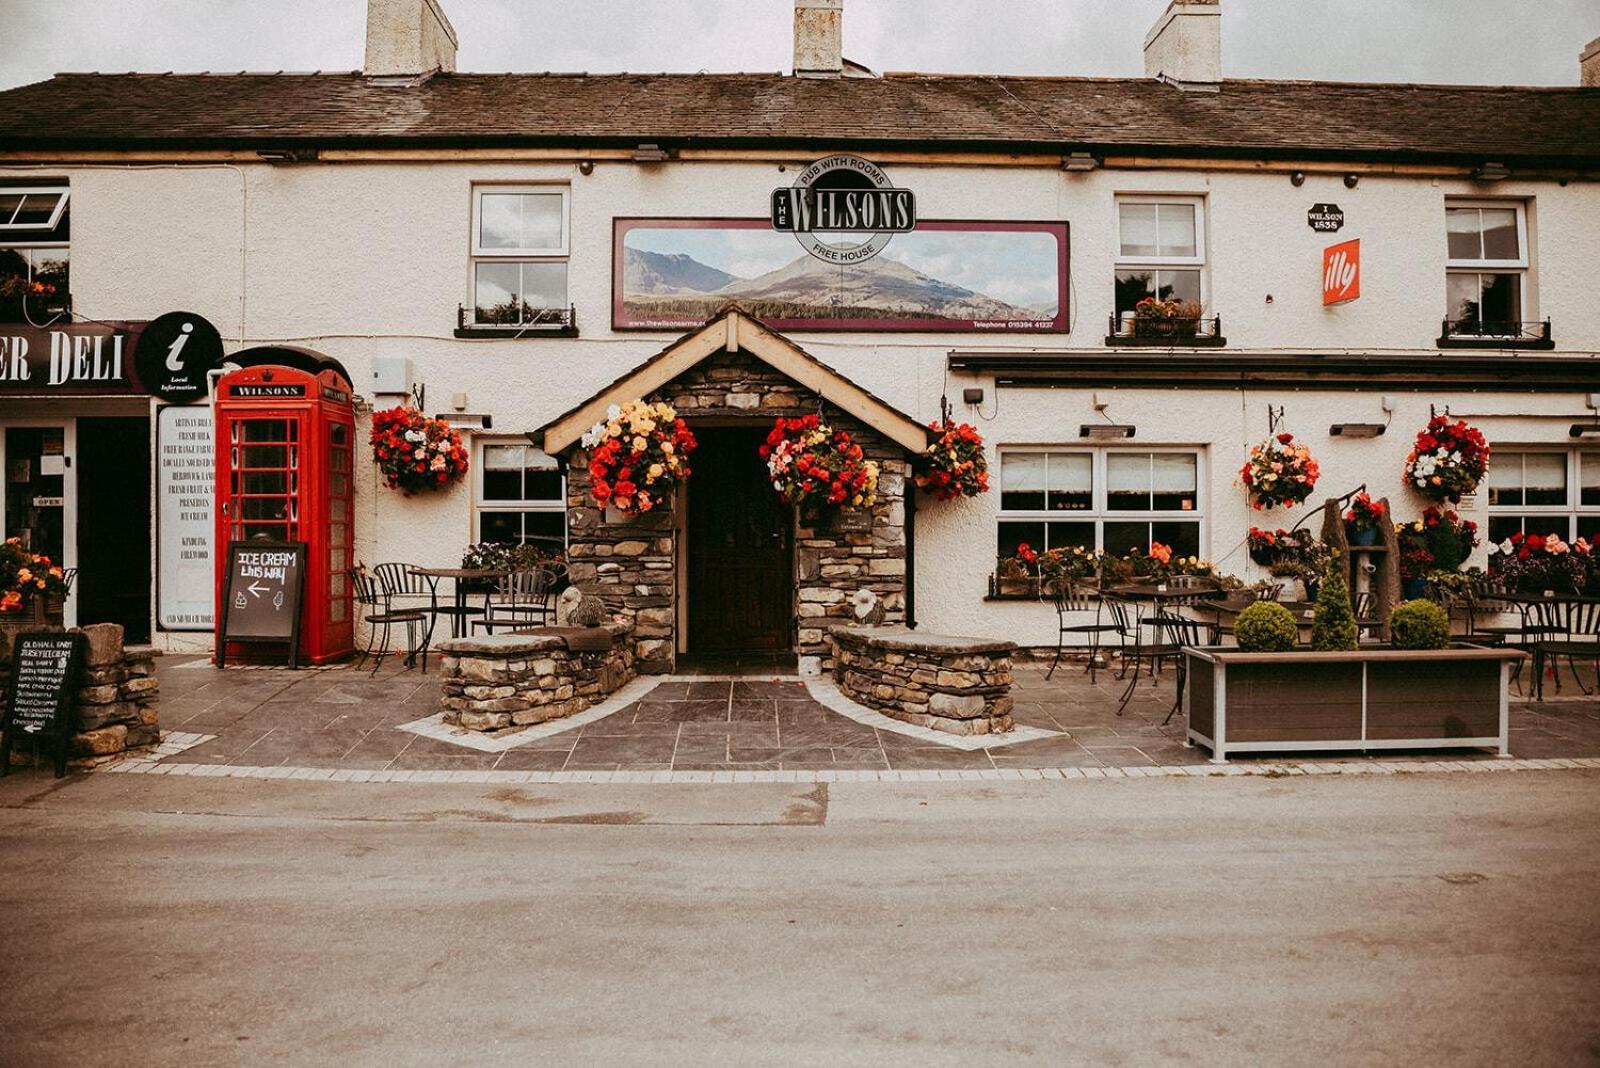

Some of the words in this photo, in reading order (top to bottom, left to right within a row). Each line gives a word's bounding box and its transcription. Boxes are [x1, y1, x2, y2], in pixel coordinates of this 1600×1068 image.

[801, 166, 821, 185] PUB
[821, 157, 848, 170] WITH
[850, 158, 885, 185] ROOMS
[778, 196, 786, 225] THE
[790, 188, 909, 232] WILSONS
[1308, 213, 1343, 221] WILSON
[813, 243, 838, 261] FREE
[840, 244, 875, 261] HOUSE
[1324, 250, 1357, 297] illy
[973, 321, 1006, 329] Telephone
[47, 331, 124, 386] DELI
[170, 376, 188, 384] Local
[160, 384, 198, 392] Information
[238, 386, 299, 396] WILSONS
[238, 553, 260, 566] ICE
[260, 552, 297, 567] CREAM
